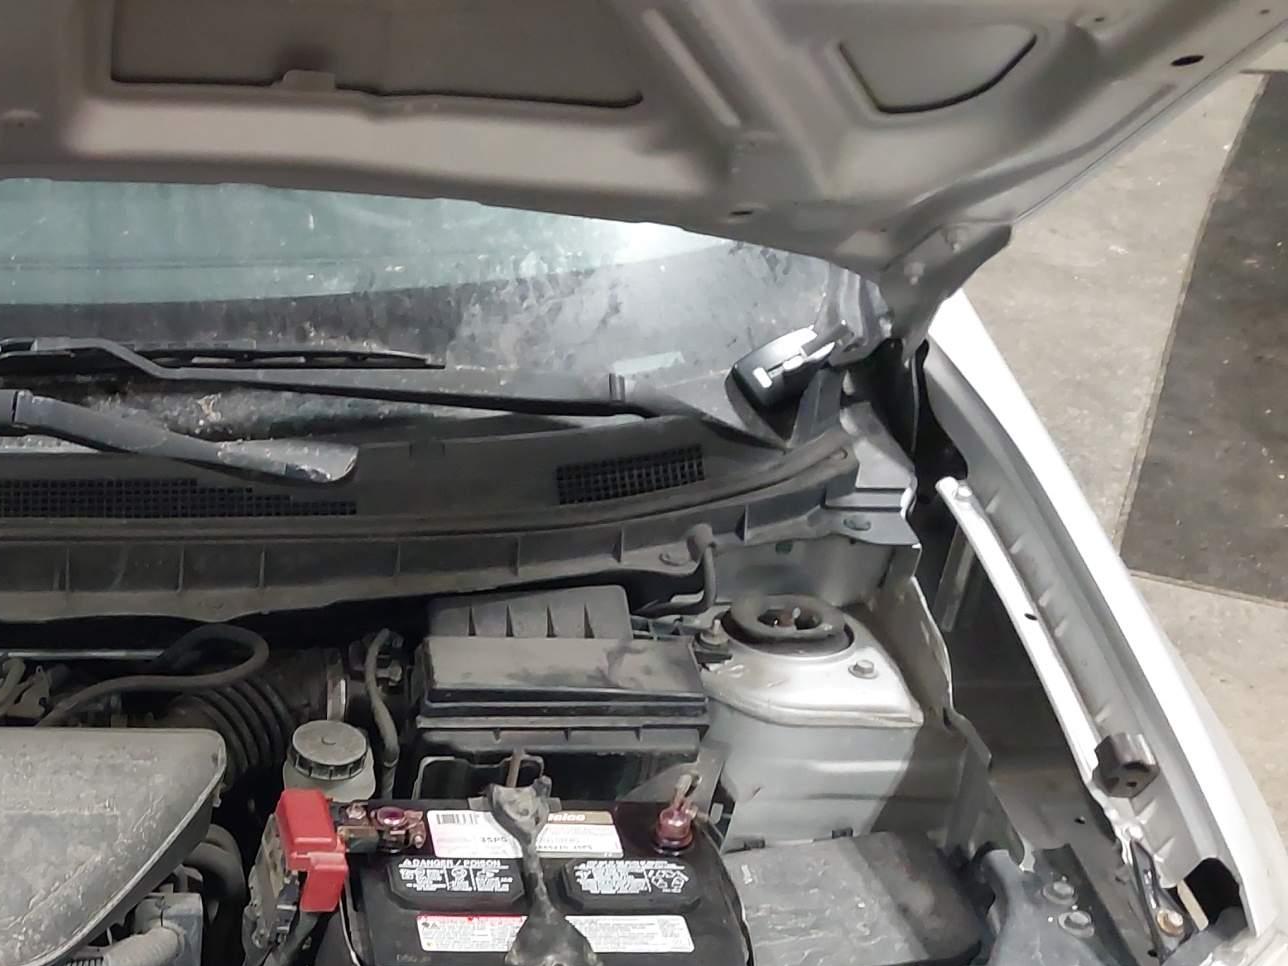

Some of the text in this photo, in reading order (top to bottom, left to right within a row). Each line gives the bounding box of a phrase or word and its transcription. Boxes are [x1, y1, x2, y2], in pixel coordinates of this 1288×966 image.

[547, 813, 587, 822] elco
[412, 859, 454, 869] DANGER
[464, 860, 502, 868] POISON
